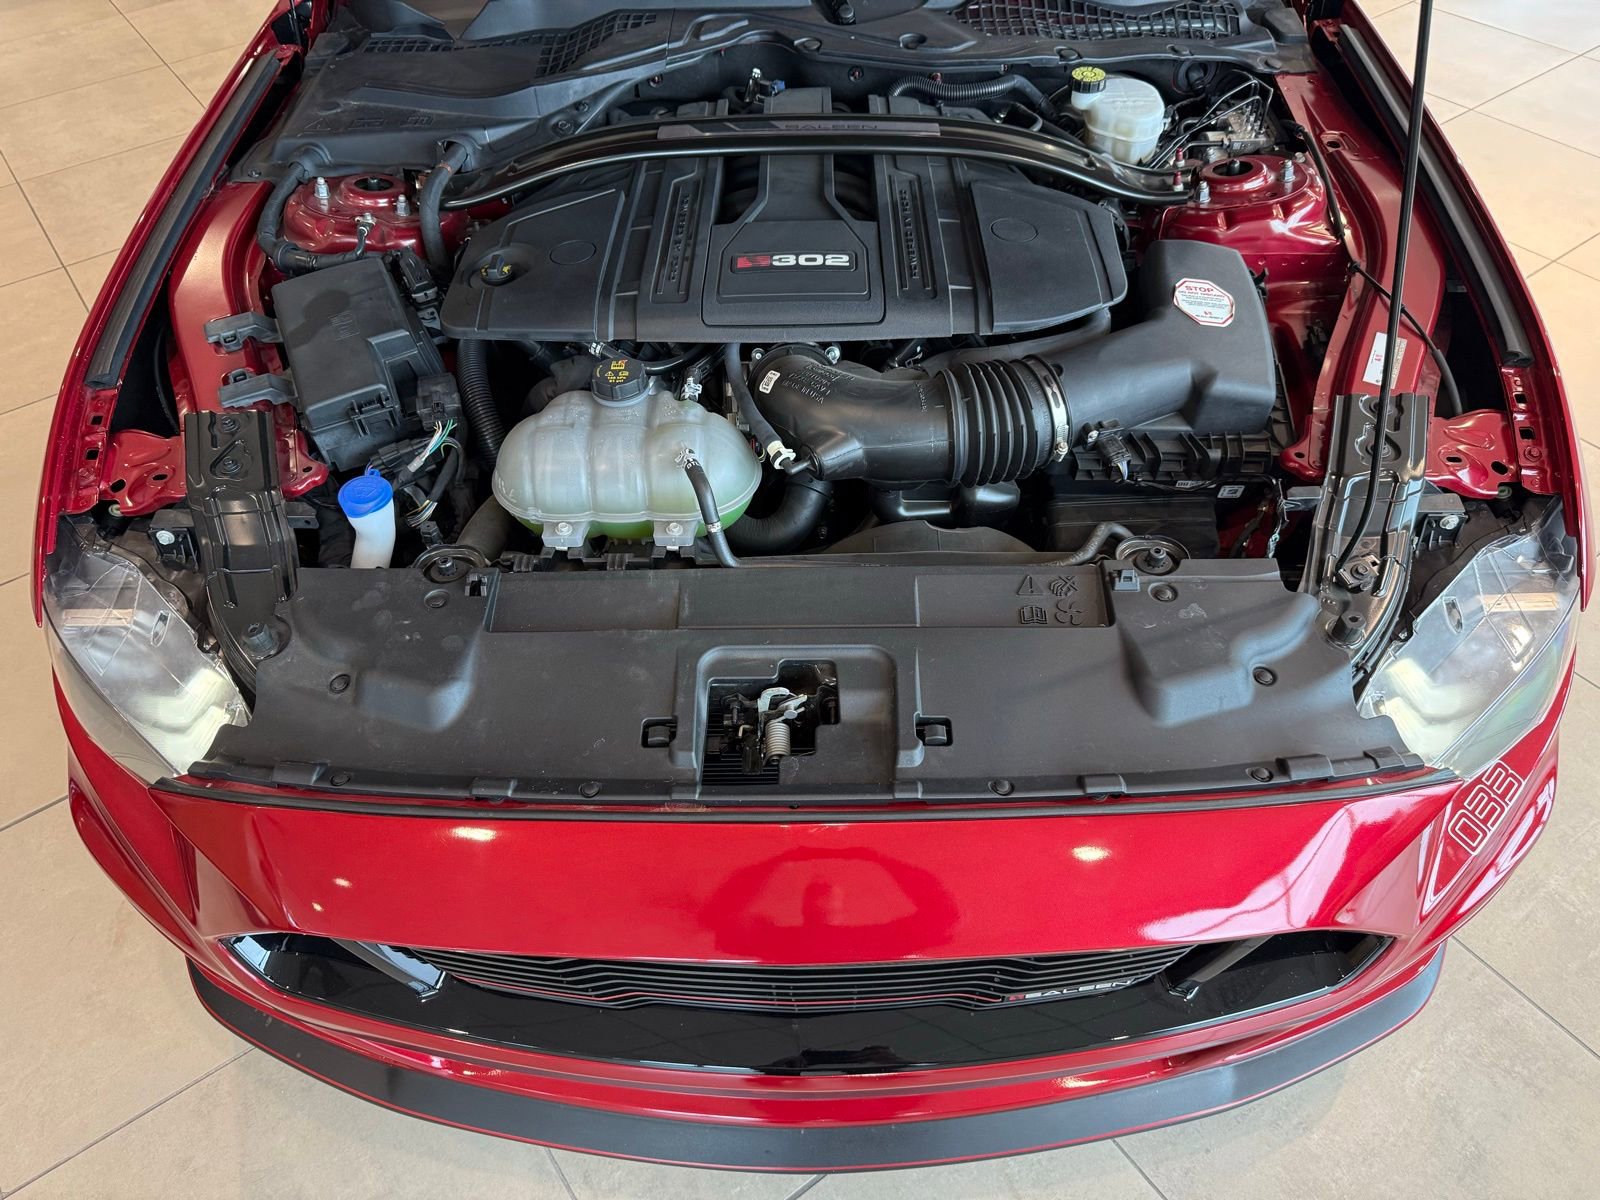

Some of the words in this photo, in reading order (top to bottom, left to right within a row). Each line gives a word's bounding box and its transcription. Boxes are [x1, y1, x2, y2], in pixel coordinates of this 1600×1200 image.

[1184, 284, 1215, 293] STOP
[1447, 760, 1526, 855] 033
[1025, 980, 1131, 999] SALEEN
